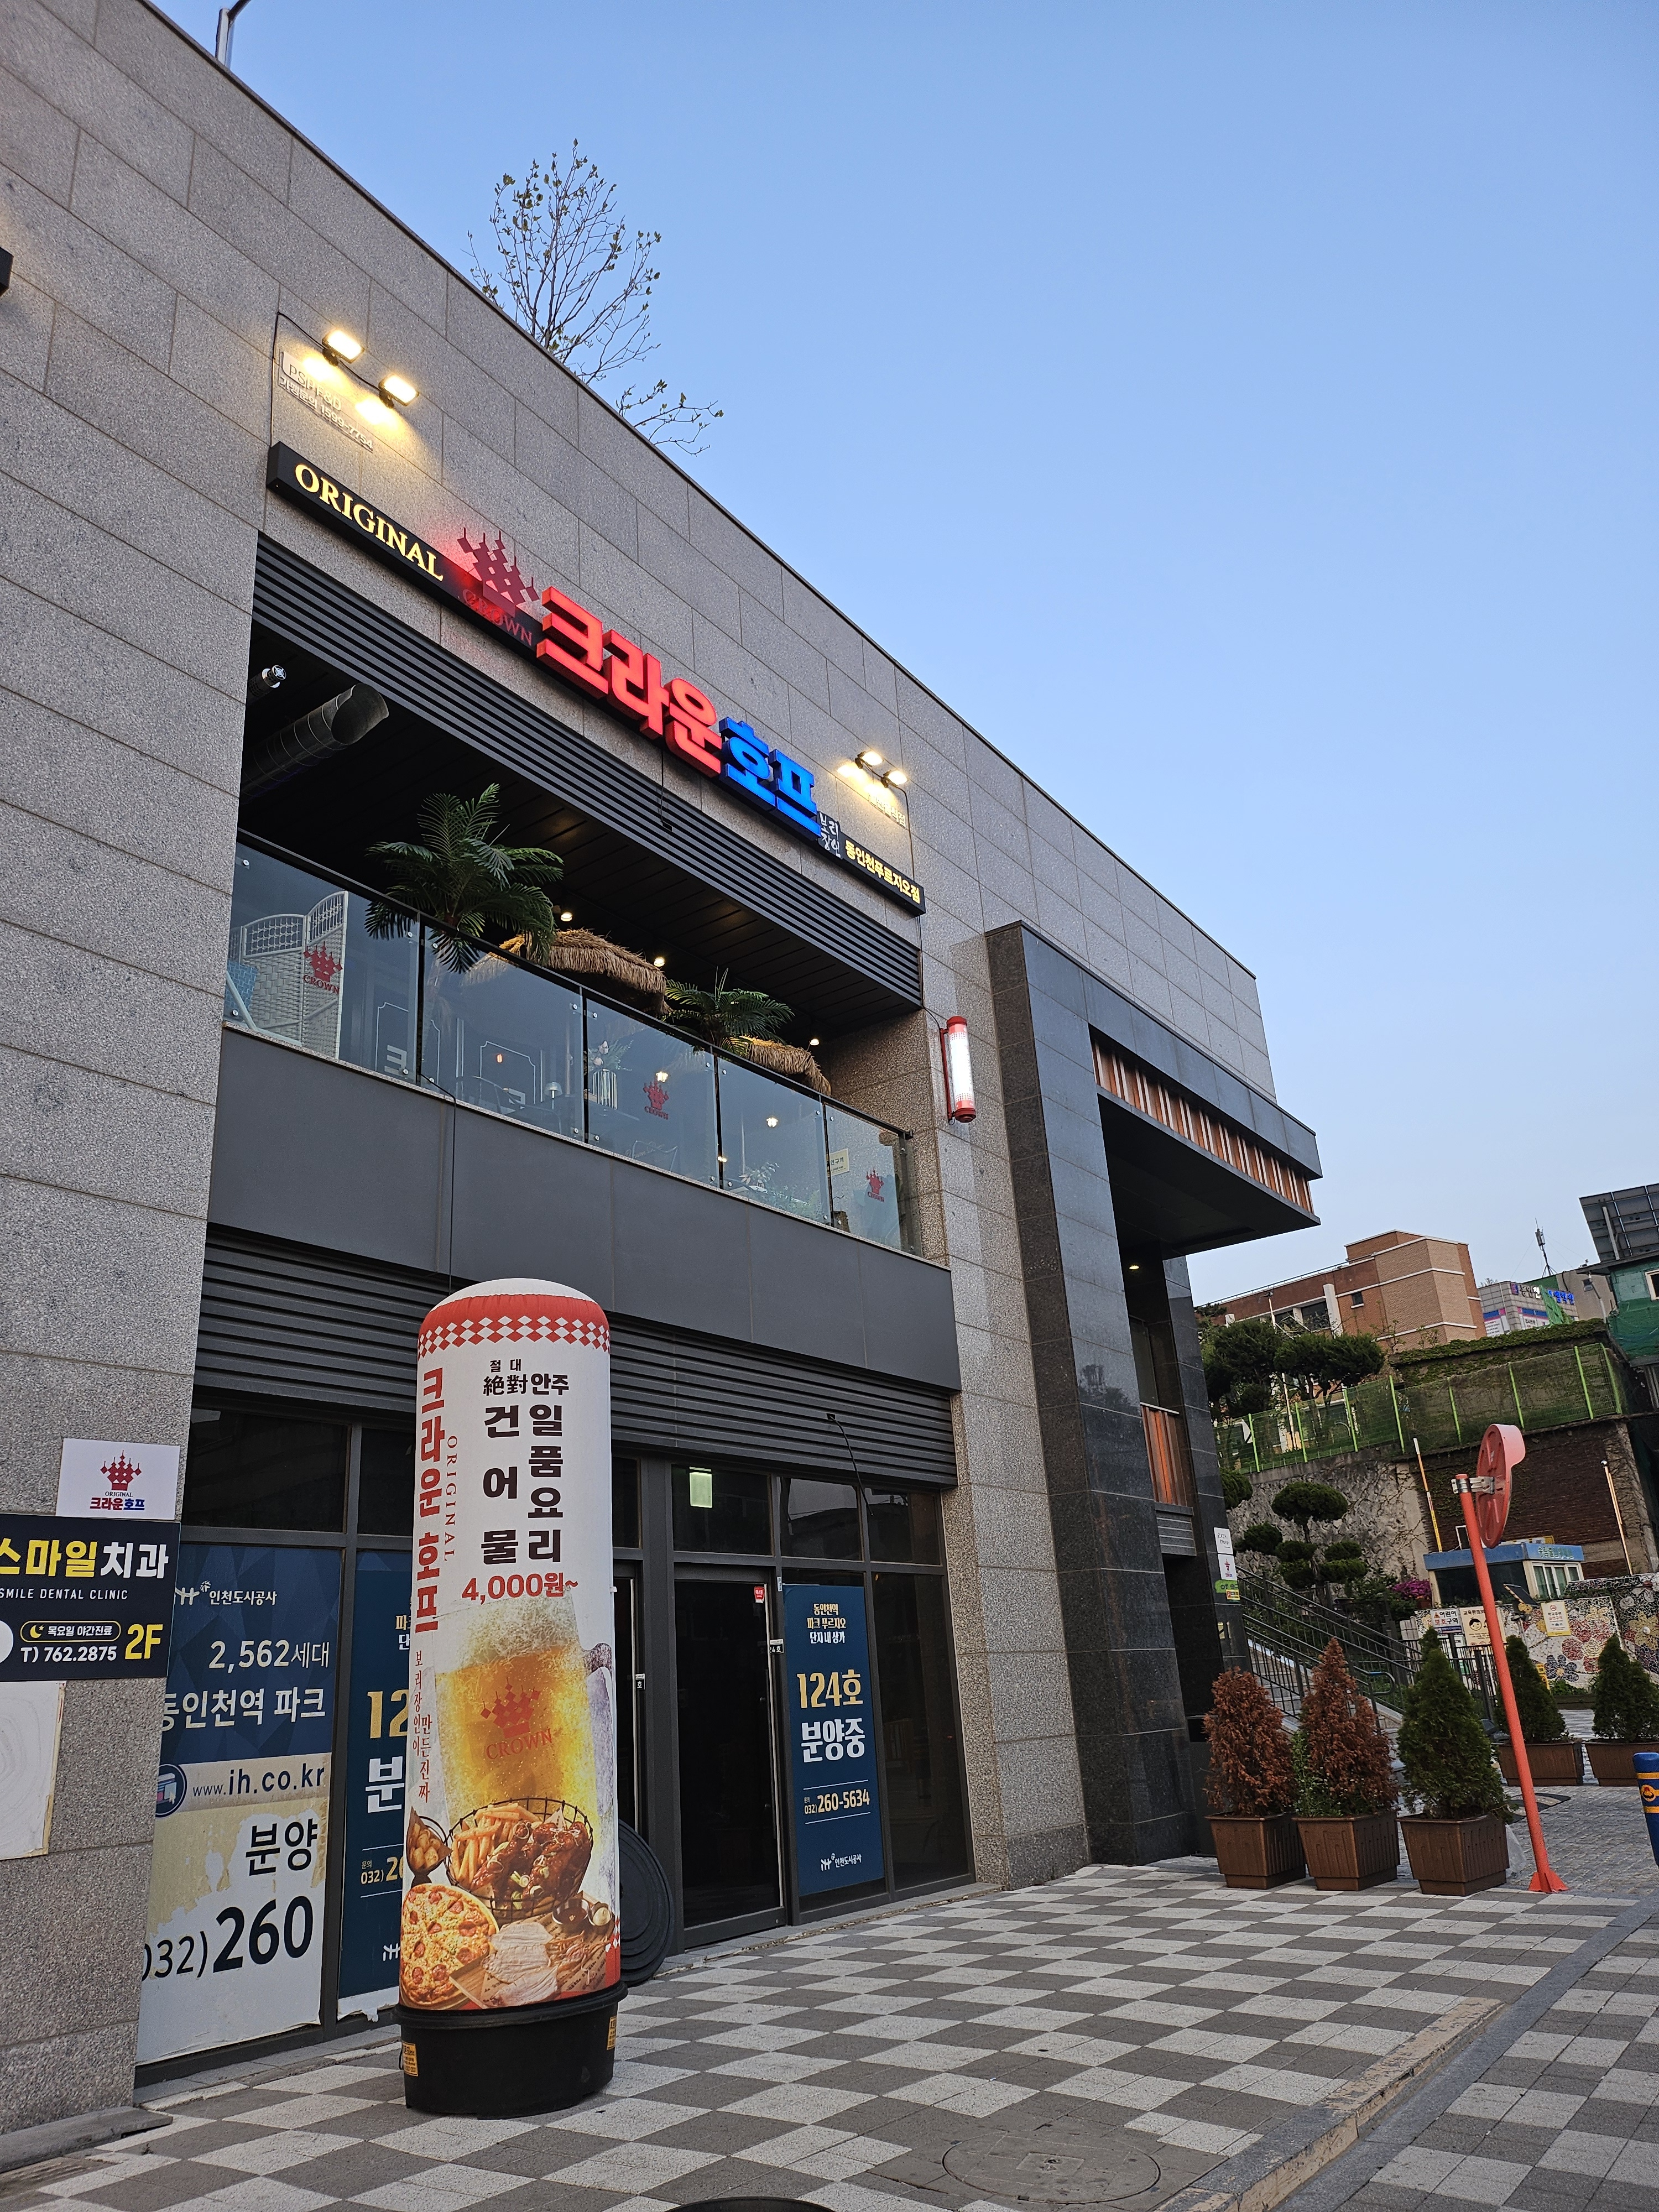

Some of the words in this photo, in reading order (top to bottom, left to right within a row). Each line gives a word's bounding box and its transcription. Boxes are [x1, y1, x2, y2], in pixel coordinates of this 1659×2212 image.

[279, 376, 317, 409] 가맹문의
[320, 404, 373, 450] 1599-7754
[295, 463, 444, 582] ORIGINAL
[462, 589, 533, 646] CROWN
[536, 586, 821, 838] 크라운호프
[819, 812, 839, 839] 보리
[821, 833, 841, 858] 장인
[845, 839, 921, 904] 동인천푸르지오점
[303, 974, 340, 995] CROWN
[444, 1435, 458, 1562] ORIGINAL
[481, 1405, 520, 1565] 건어물
[528, 1404, 564, 1563] 일품요리
[89, 1497, 145, 1511] 크라운호프
[0, 1588, 34, 1599] SMILE
[40, 1589, 85, 1600] DENTAL
[90, 1589, 128, 1600] CLINIC
[209, 1590, 278, 1606] 인천도시공사
[461, 1572, 578, 1605] 4,000원~
[807, 1617, 821, 1630] 파크
[821, 1617, 847, 1630] 푸르지오
[813, 1603, 839, 1615] 동인천역
[48, 1625, 75, 1636] 목요일
[77, 1625, 113, 1636] 야간진료
[124, 1624, 163, 1660] 2F
[810, 1631, 823, 1644] 단지
[824, 1631, 831, 1644] 내
[832, 1631, 846, 1644] 상가
[20, 1647, 39, 1663] T)
[44, 1646, 117, 1662] 762.2875
[208, 1640, 330, 1673] 2,562세대
[274, 1687, 326, 1723] 파크
[413, 1650, 423, 1756] 보리장인이
[796, 1669, 863, 1709] 124호
[486, 1728, 552, 1760] CROWN
[801, 1718, 865, 1763] 분양중
[192, 1762, 325, 1797] www.ih.co.kr
[365, 1755, 405, 1813] 분
[245, 1818, 319, 1876] 분양
[834, 1853, 862, 1868] 인천도시공사
[361, 1860, 372, 1870] 문의
